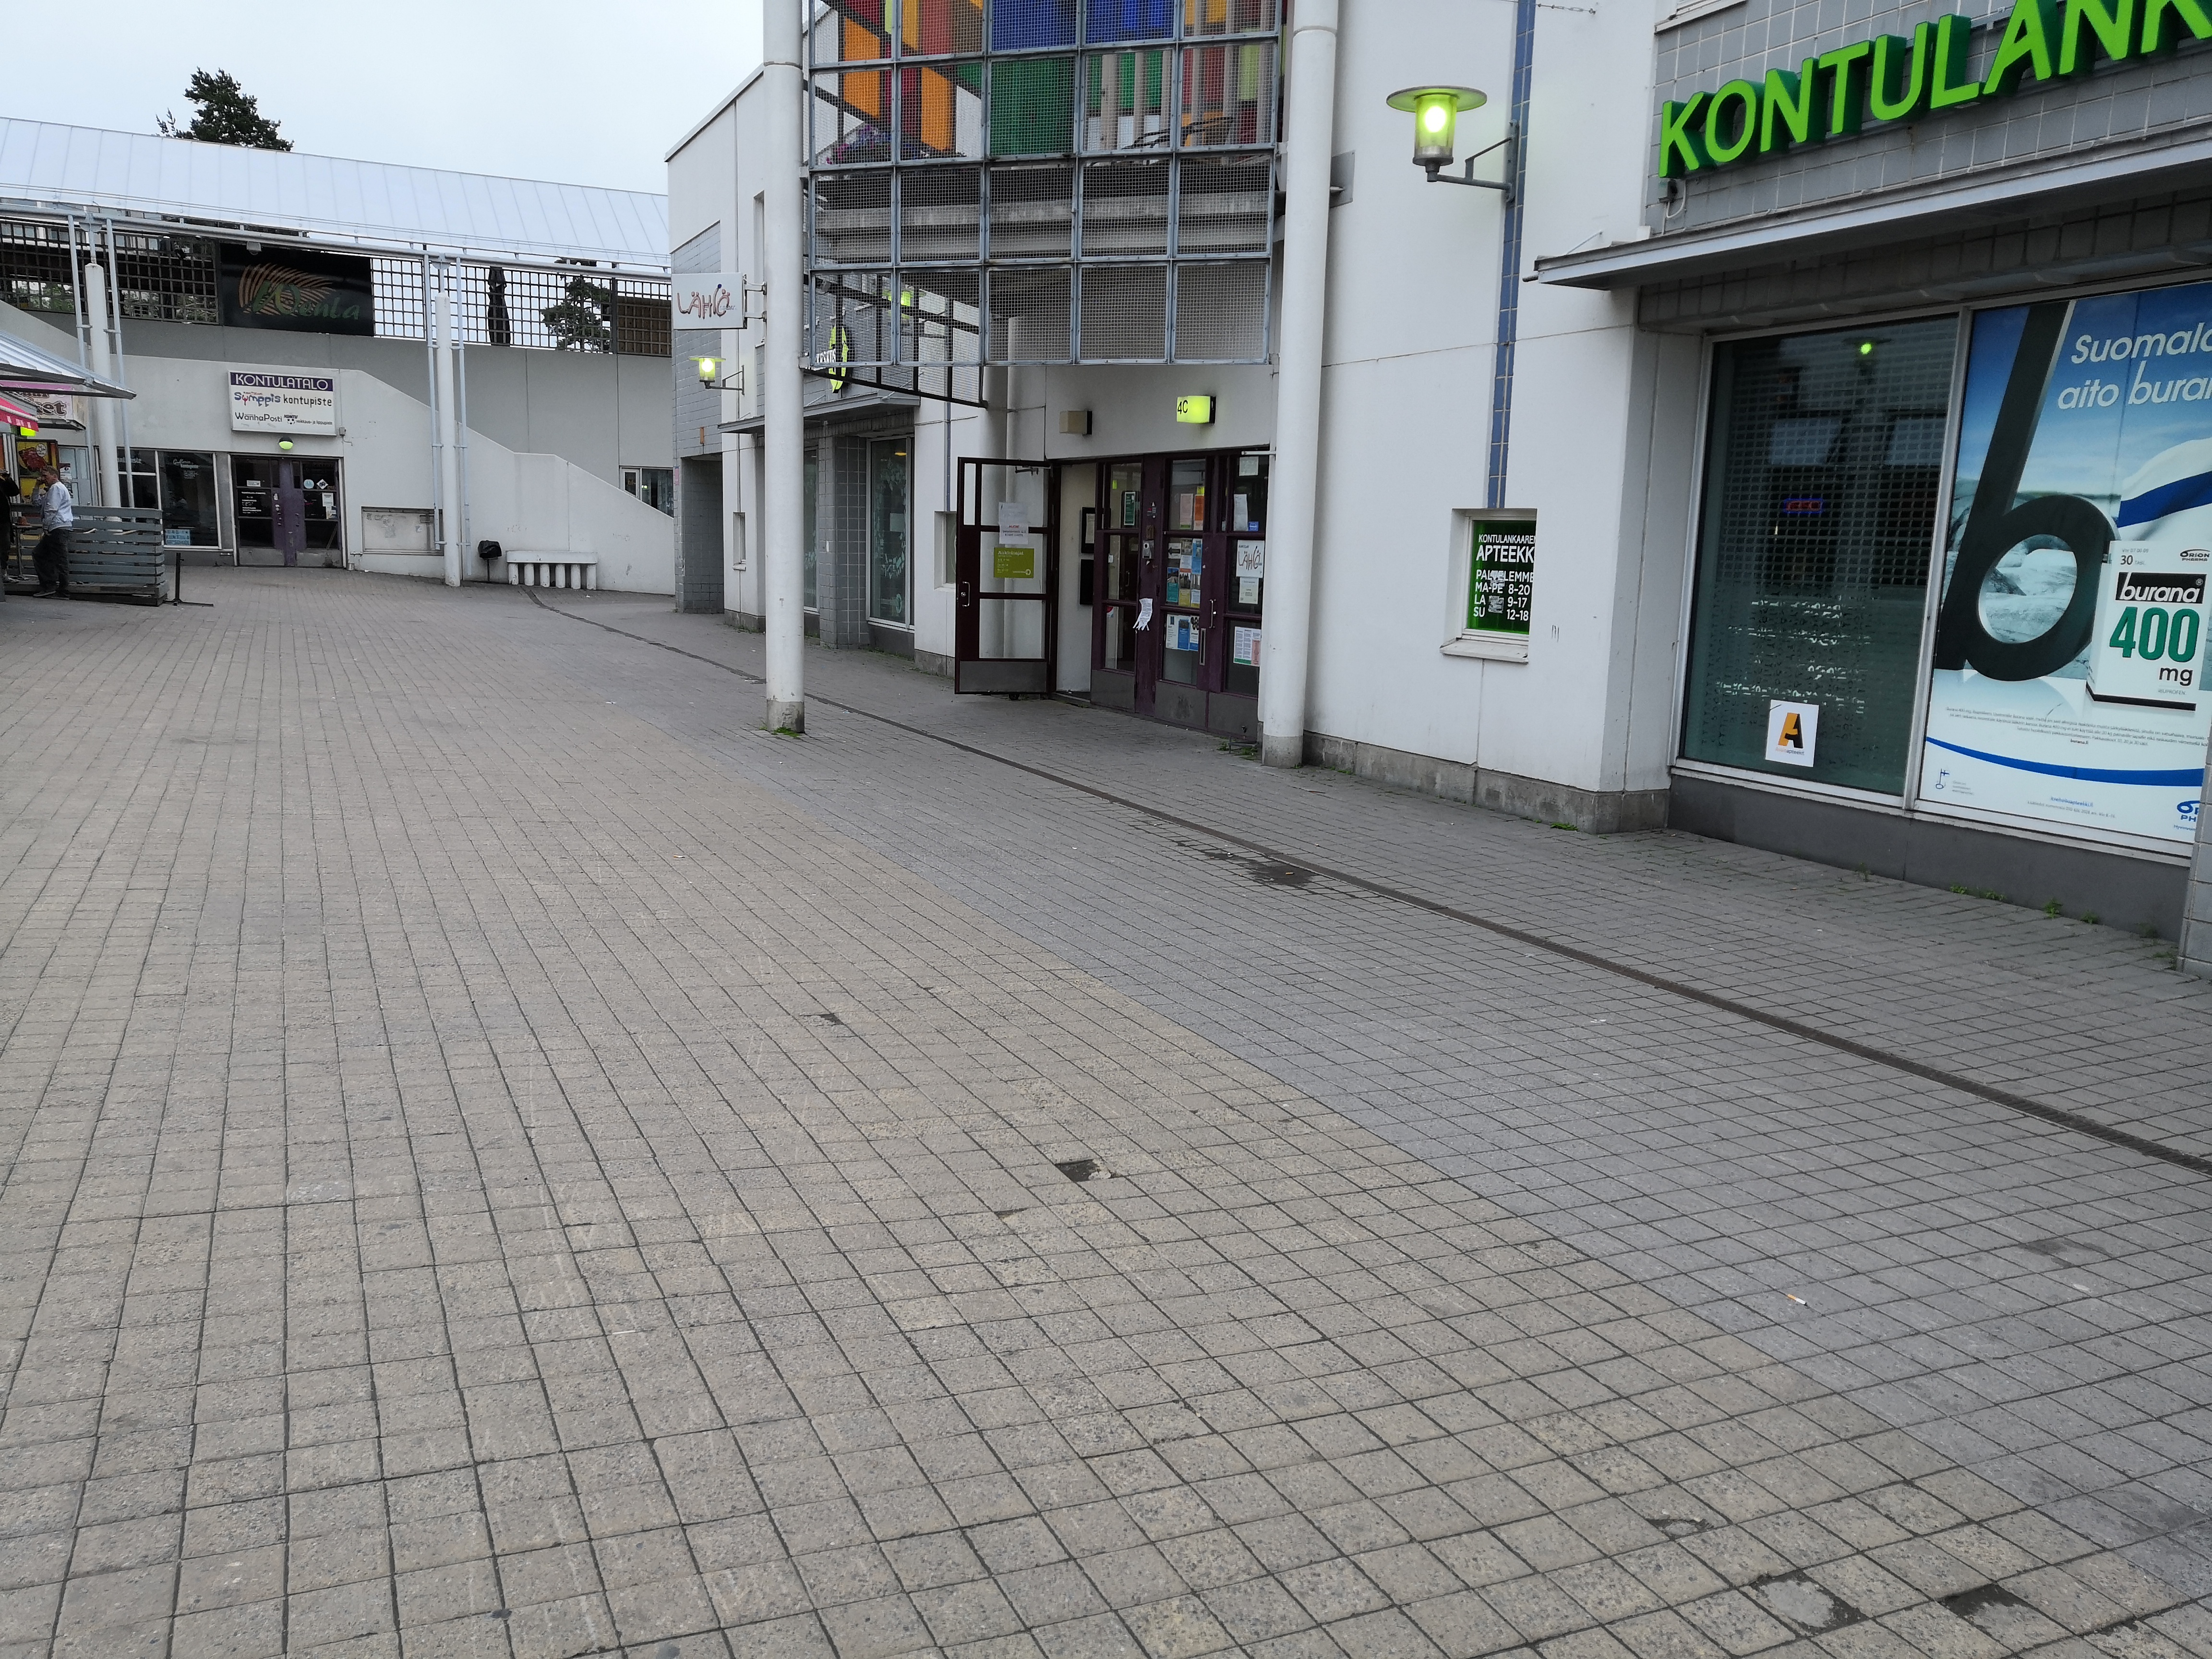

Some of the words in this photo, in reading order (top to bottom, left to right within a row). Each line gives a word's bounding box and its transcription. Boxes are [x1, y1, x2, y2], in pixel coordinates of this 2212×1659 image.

[235, 373, 328, 390] KONTULATALO
[283, 394, 332, 408] kontupiste
[2058, 379, 2120, 409] aito
[1178, 399, 1188, 414] 4C
[2120, 555, 2133, 565] 30
[2180, 549, 2211, 558] ORION
[1475, 582, 1503, 594] MA-PE
[1508, 584, 1531, 595] 8-20
[2119, 572, 2201, 603] burana
[1474, 594, 1486, 605] LA
[1507, 597, 1527, 608] 9-17
[1473, 606, 1485, 617] SU
[1506, 609, 1529, 621] 12-18
[2109, 606, 2200, 663] 400
[2159, 667, 2193, 686] mg
